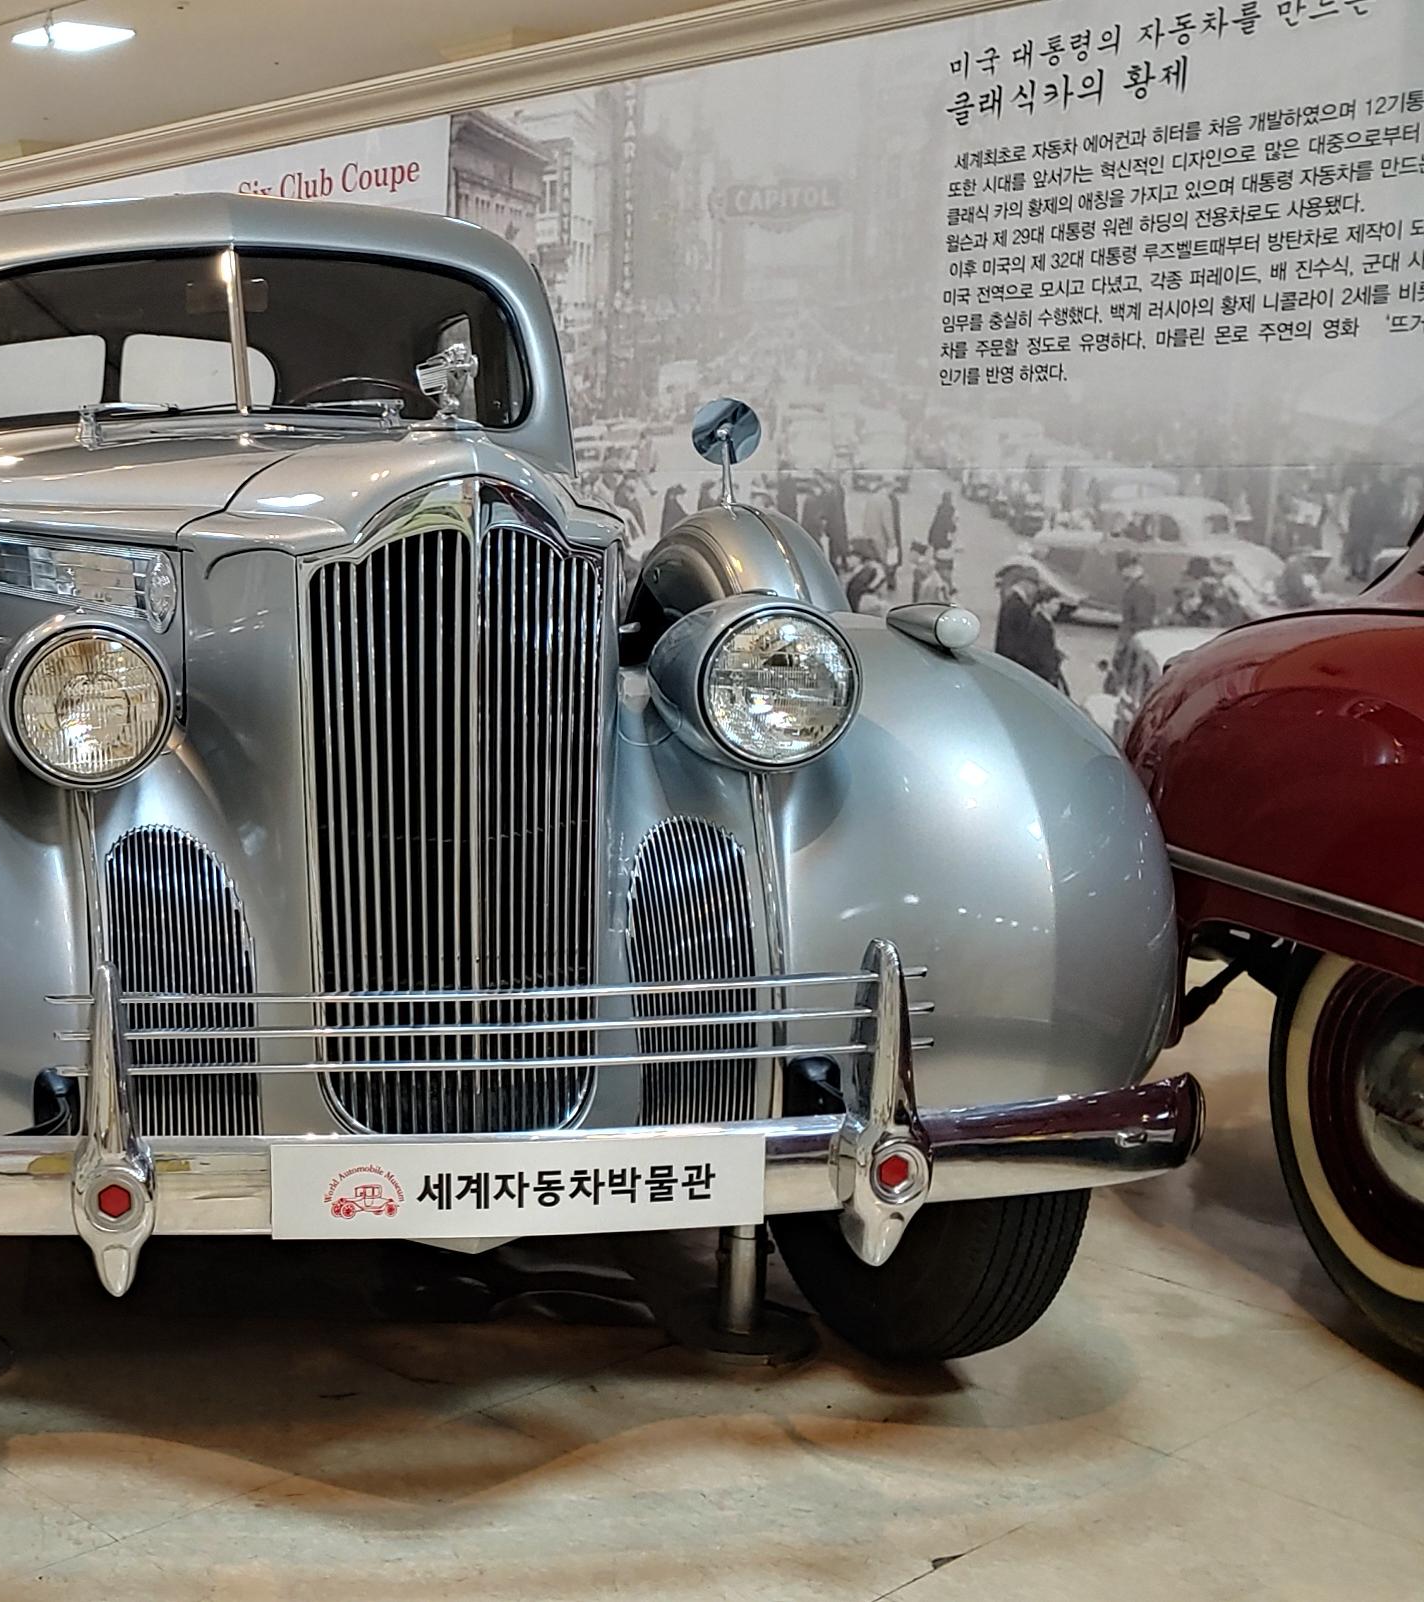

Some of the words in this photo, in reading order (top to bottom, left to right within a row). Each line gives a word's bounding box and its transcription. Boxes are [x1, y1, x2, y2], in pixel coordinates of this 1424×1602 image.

[949, 47, 1000, 80] 미국
[1012, 24, 1121, 69] 대통령의
[1137, 1, 1262, 50] 자동차를
[1123, 55, 1188, 100] 황제
[947, 178, 977, 197] 또한
[982, 172, 1026, 194] 시대를
[1032, 165, 1094, 189] 앞서가는
[1100, 154, 1164, 180] 혁신적인
[1172, 145, 1256, 171] 디자인으로
[1264, 138, 1300, 162] 많은
[1309, 122, 1420, 155] 대중으로부터
[954, 145, 1027, 170] 세계최초로
[1032, 137, 1078, 160] 자동차
[1083, 128, 1147, 153] 에어컨과
[1153, 121, 1202, 143] 히터를
[1208, 115, 1243, 137] 처음
[1249, 99, 1356, 133] 개발하였으며
[280, 167, 334, 200] Club
[341, 160, 421, 193] Coupe
[947, 204, 989, 226] 클래식
[994, 200, 1023, 220] 카의
[1028, 194, 1073, 217] 황제의
[1078, 188, 1125, 211] 애칭을
[1130, 184, 1179, 205] 가지고
[1185, 176, 1235, 200] 있으며
[1242, 169, 1294, 194] 대통령
[1300, 160, 1374, 187] 자동차를
[992, 229, 1007, 247] 제
[1012, 225, 1045, 245] 29대
[1051, 219, 1096, 242] 대통령
[1103, 215, 1133, 237] 워렌
[1139, 211, 1188, 233] 하딩의
[1195, 203, 1281, 229] 전용차로도
[1287, 193, 1365, 218] 사용됐다.
[949, 259, 977, 279] 이후
[982, 255, 1026, 276] 미국의
[1030, 253, 1045, 271] 제
[1051, 248, 1084, 270] 32대
[1090, 245, 1136, 267] 대통령
[1142, 233, 1260, 262] 루즈벨트때부터
[1268, 226, 1339, 251] 방탄차로
[1346, 218, 1403, 244] 제작이
[943, 286, 971, 306] 미국
[976, 282, 1034, 304] 전역으로
[1039, 279, 1085, 298] 모시고
[1091, 274, 1142, 294] 다녔고,
[1150, 270, 1183, 290] 각종
[1189, 264, 1262, 287] 퍼레이드,
[1270, 261, 1287, 281] 배
[1295, 255, 1354, 280] 진수식,
[1362, 251, 1400, 274] 군대
[942, 313, 983, 333] 임무를
[988, 309, 1032, 331] 충실히
[1037, 304, 1103, 327] 수행했다.
[1110, 301, 1141, 322] 백계
[1148, 296, 1214, 320] 러시아의
[1220, 293, 1256, 316] 황제
[1263, 288, 1334, 312] 니콜라이
[1341, 283, 1391, 306] 2세를
[940, 341, 968, 360] 차를
[975, 338, 1019, 358] 주문할
[1027, 335, 1071, 356] 정도로
[1078, 330, 1146, 353] 유명하다.
[1214, 324, 1249, 345] 몬로
[1258, 320, 1312, 342] 주연의
[1323, 316, 1360, 339] 영화
[940, 367, 981, 386] 인기를
[986, 364, 1015, 384] 반영
[1020, 362, 1068, 383] 하였다.
[324, 1178, 340, 1203] World
[338, 1164, 385, 1181] Automobile
[384, 1170, 406, 1202] Museum
[416, 1162, 717, 1211] 세계자동차박물관
